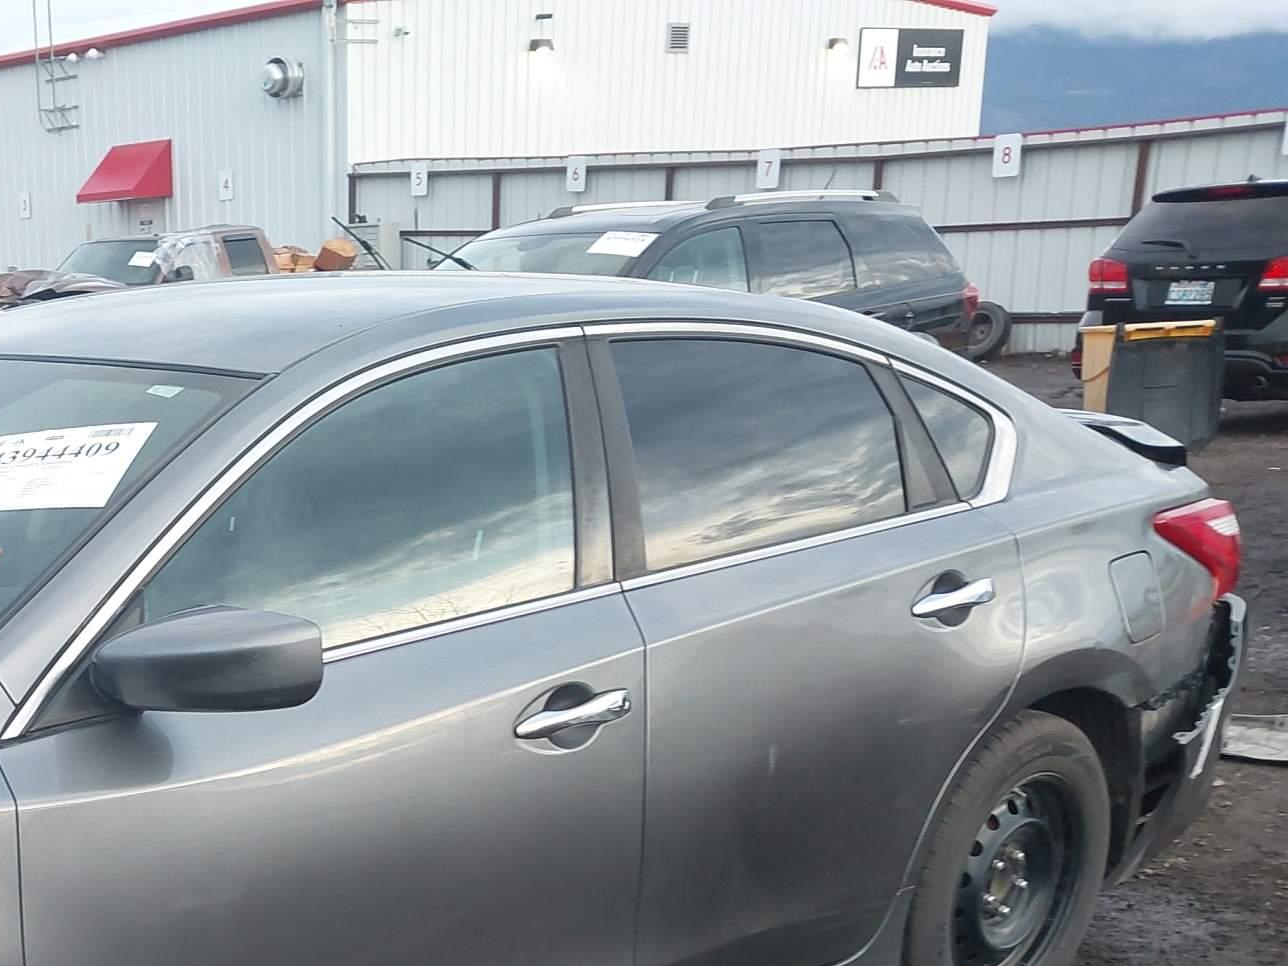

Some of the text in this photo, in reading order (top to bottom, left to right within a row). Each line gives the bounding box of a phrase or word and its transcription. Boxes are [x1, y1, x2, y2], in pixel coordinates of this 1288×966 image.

[1002, 147, 1012, 164] 8
[572, 166, 580, 181] 6
[765, 161, 773, 177] 7
[222, 178, 230, 191] 4
[415, 172, 423, 186] 5
